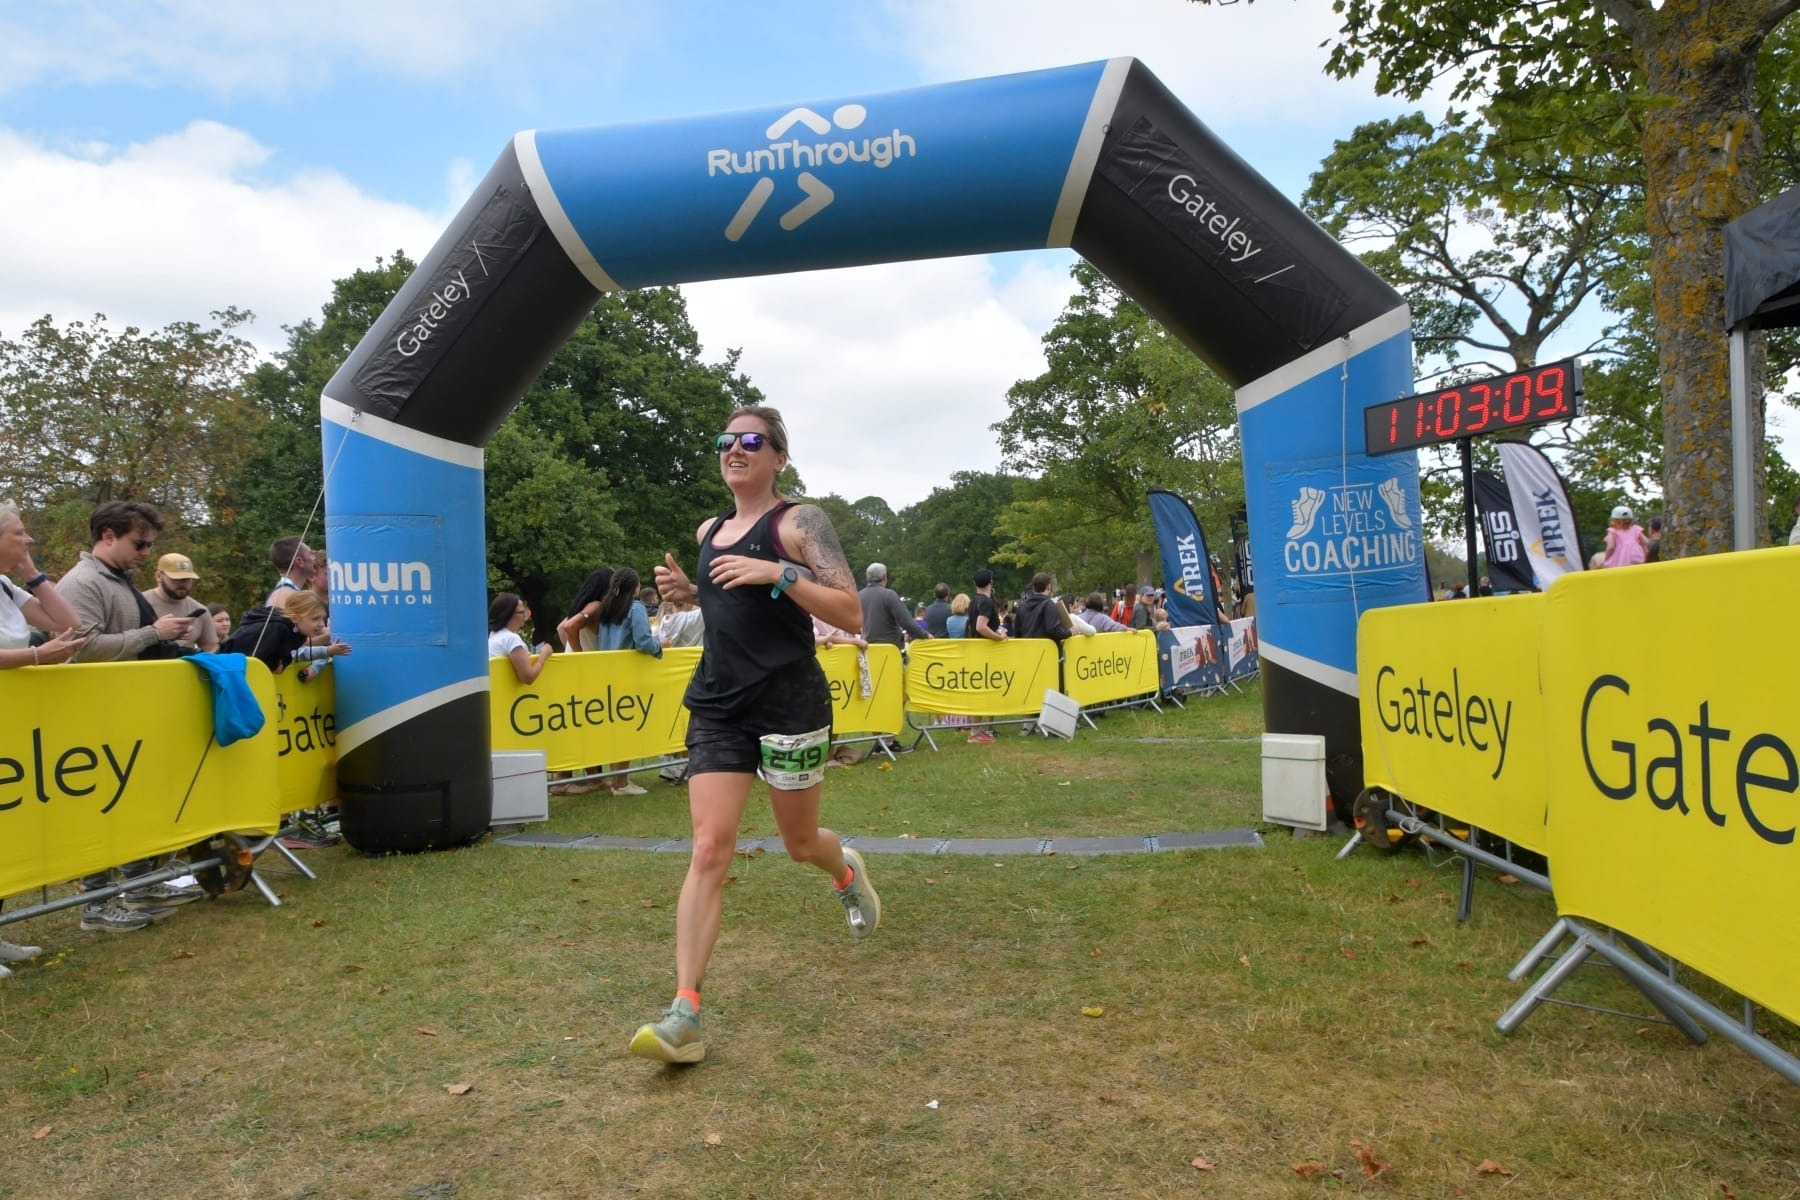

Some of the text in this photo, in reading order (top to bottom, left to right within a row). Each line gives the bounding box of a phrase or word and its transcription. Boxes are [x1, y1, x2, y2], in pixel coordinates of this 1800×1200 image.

[707, 128, 916, 177] RunThrough
[1168, 174, 1262, 262] Gateley
[397, 271, 470, 356] Gateley
[1321, 510, 1386, 537] LEVELS
[1333, 490, 1373, 513] NEW
[1532, 487, 1566, 559] TREK
[1176, 532, 1204, 597] TREK
[1284, 530, 1416, 573] COACHING
[330, 561, 432, 592] nuun
[925, 662, 1016, 697] Gateley
[1076, 651, 1132, 680] Gateley
[510, 684, 655, 737] Gateley
[1376, 665, 1513, 781] Gateley
[769, 745, 822, 770] 249
